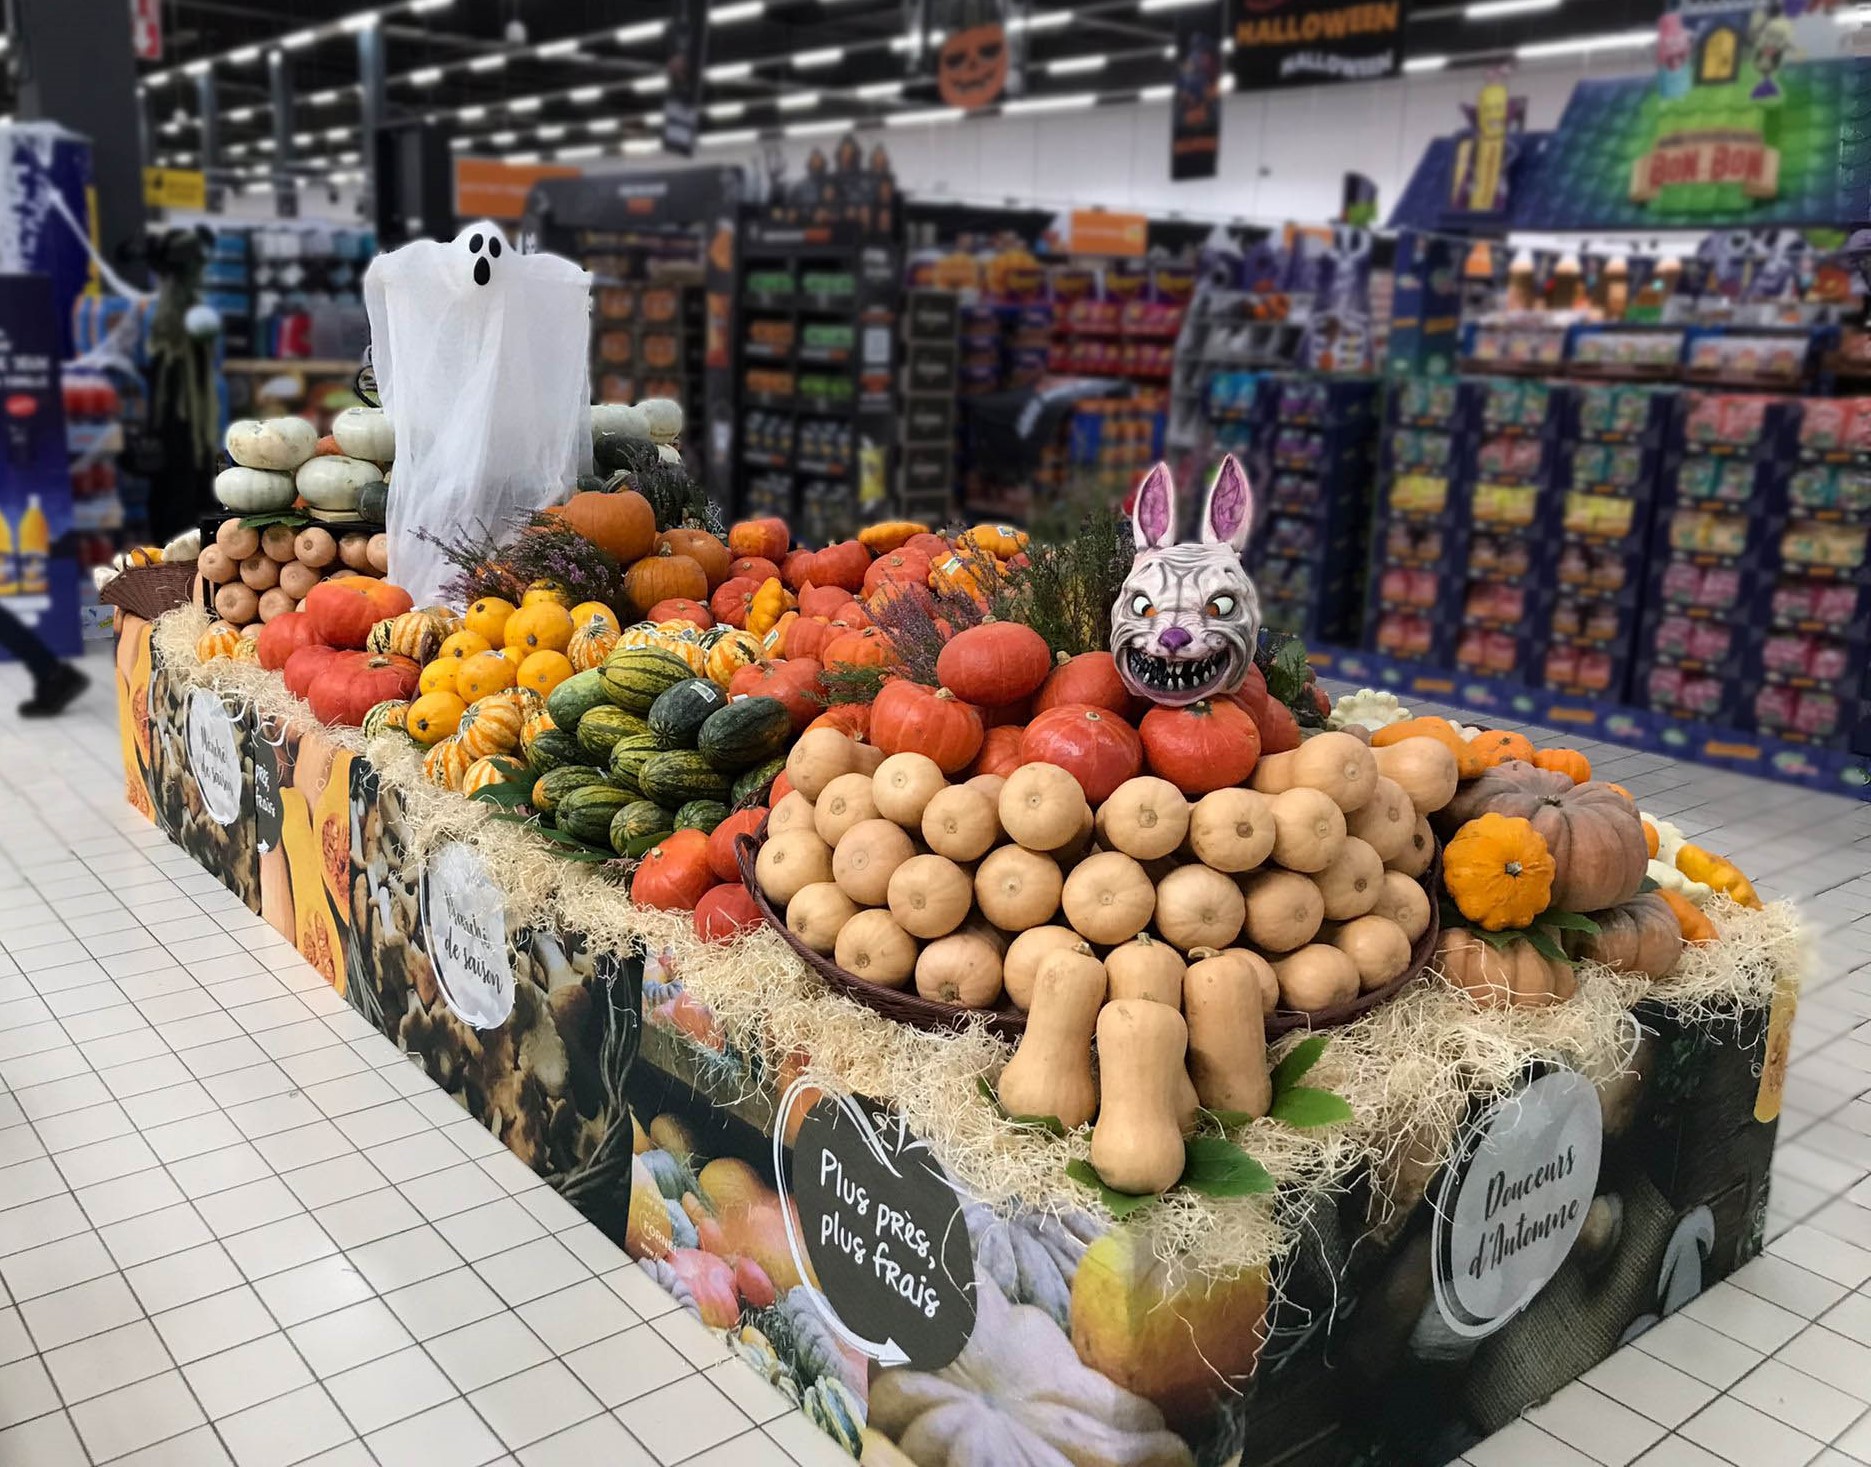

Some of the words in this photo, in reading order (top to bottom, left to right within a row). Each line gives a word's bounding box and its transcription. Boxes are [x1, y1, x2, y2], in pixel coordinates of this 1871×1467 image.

[1235, 2, 1398, 46] HALLOWEEN
[444, 926, 460, 960] de
[463, 947, 503, 994] saison
[820, 1147, 868, 1214] Plus
[1484, 1143, 1577, 1222] Douceurs
[821, 1213, 867, 1265] plus
[873, 1242, 942, 1318] frais
[1467, 1198, 1580, 1280] d'Automne
